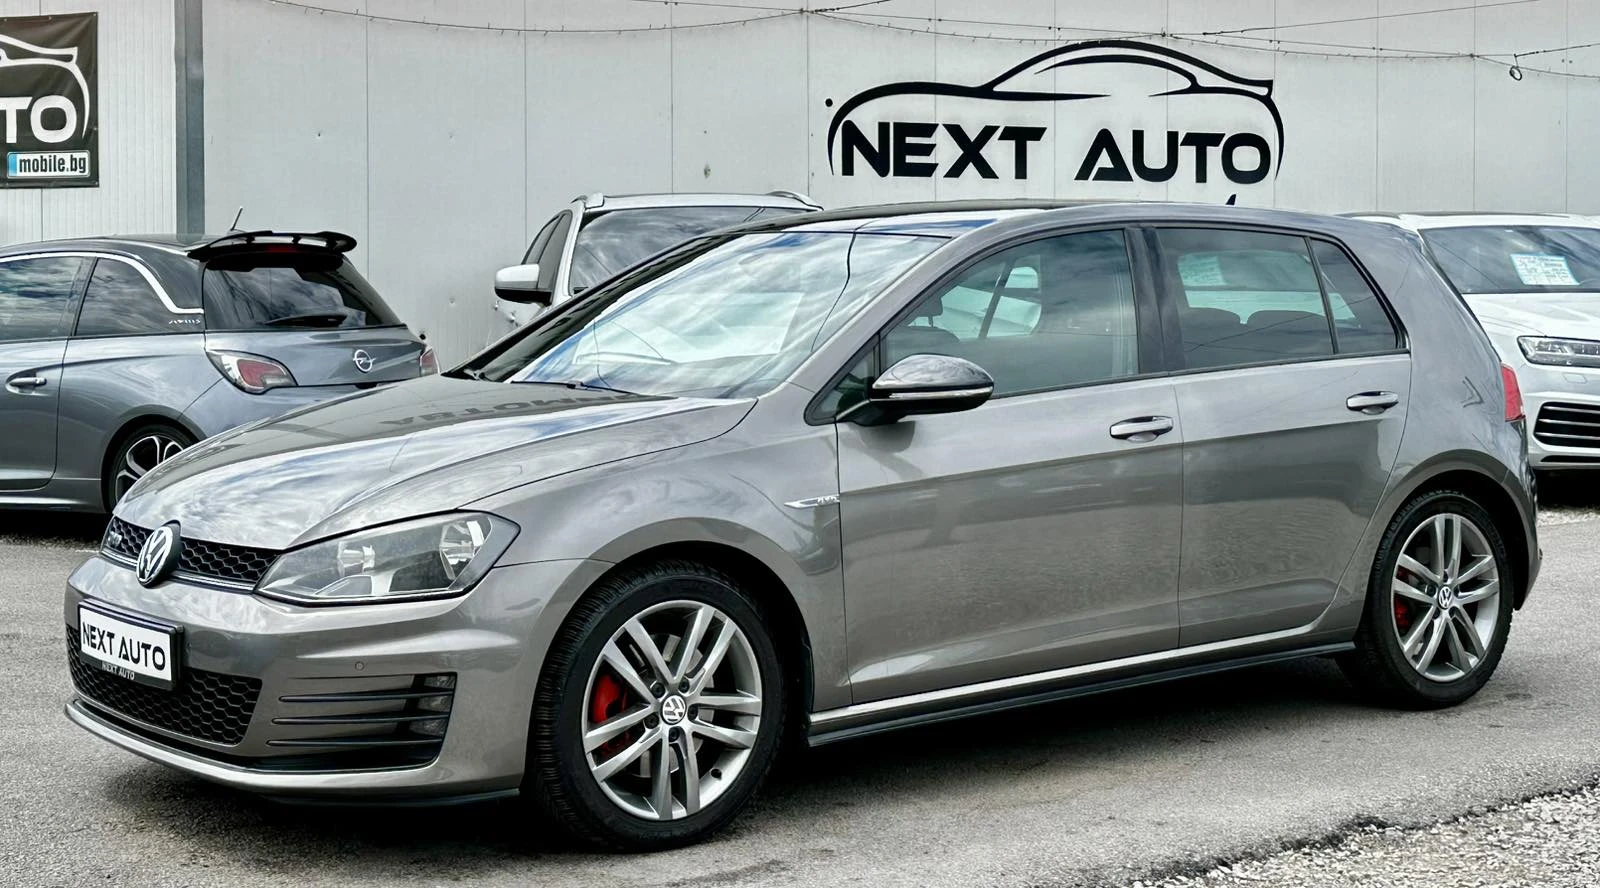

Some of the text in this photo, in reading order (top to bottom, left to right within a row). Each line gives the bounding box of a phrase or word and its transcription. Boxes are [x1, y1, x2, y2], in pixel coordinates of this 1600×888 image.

[19, 154, 87, 174] mobile.bg
[841, 119, 1271, 184] NEXT AUTO
[82, 621, 166, 671] NEXT AUTO
[101, 662, 135, 681] NEXT AUTO
